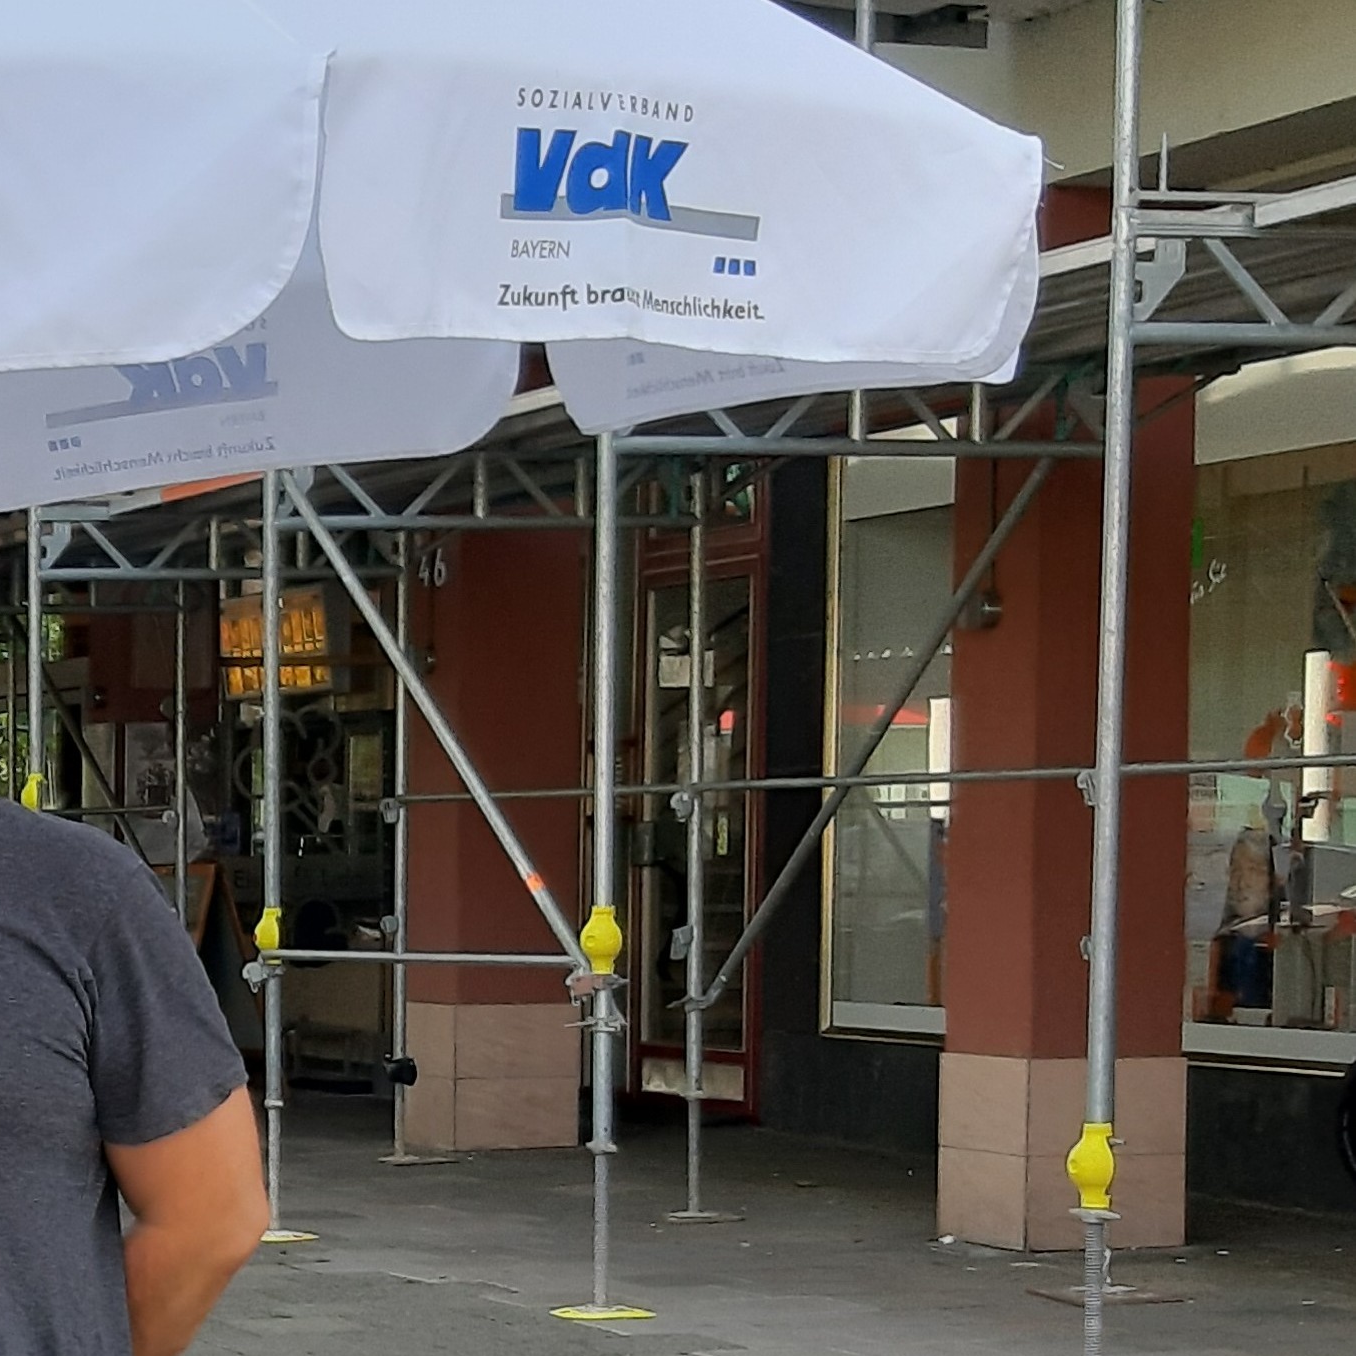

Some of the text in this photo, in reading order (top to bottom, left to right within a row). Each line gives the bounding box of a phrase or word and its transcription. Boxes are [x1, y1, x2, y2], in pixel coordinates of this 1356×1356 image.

[516, 86, 694, 123] SOZIALVERBAND
[512, 126, 690, 222] VdK
[510, 239, 571, 260] BAYERN
[497, 284, 580, 312] Zukunft
[641, 288, 766, 321] Menschlichkeit.
[418, 548, 447, 587] 46
